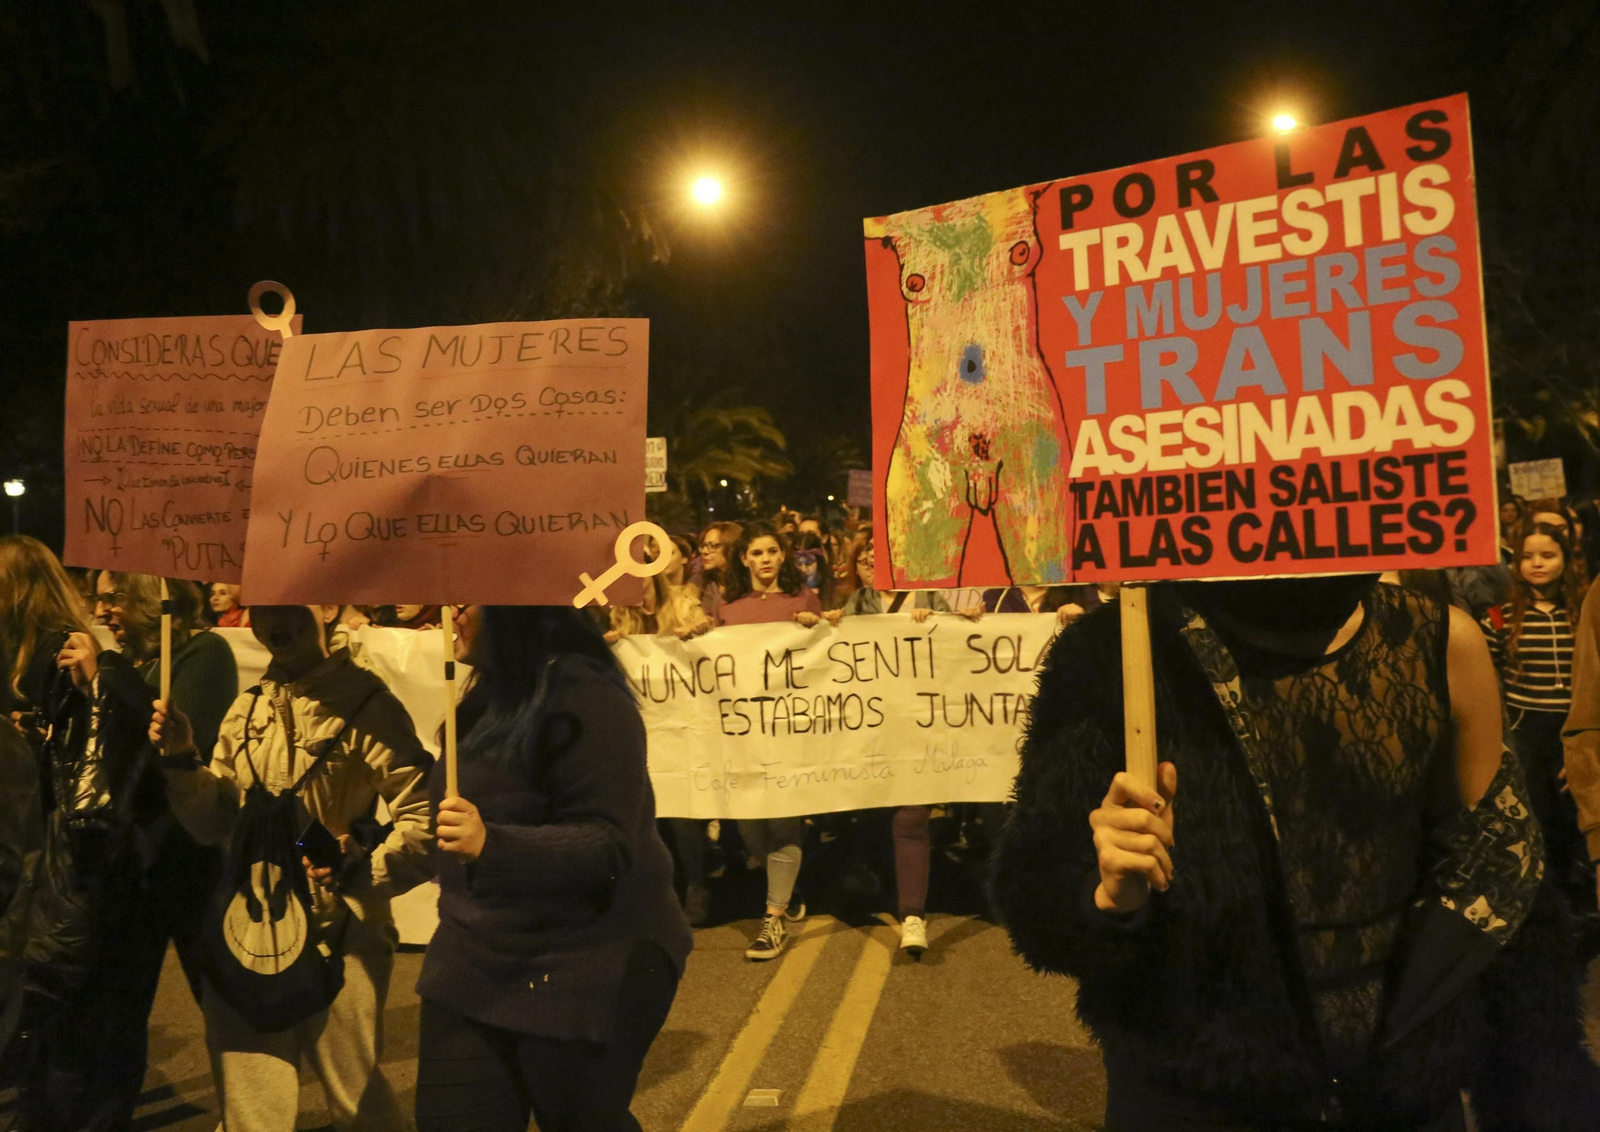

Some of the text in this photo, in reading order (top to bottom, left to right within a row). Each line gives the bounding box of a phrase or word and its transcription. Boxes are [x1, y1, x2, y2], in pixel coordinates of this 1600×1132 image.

[1059, 110, 1452, 230] POR LAS
[1059, 164, 1455, 292] TRAVESTIS
[1062, 235, 1460, 345] Y MUJERES
[76, 328, 283, 368] CONSIDERAS QUE
[305, 326, 629, 381] LAS MUJERES
[1065, 300, 1464, 415] TRANS
[298, 406, 400, 433] Deben
[414, 398, 462, 418] ser
[1068, 379, 1475, 478] ASESINADAS
[129, 435, 181, 456] DEFINE
[186, 442, 222, 462] COMO
[305, 445, 617, 485] QUIENES ELLAS QUIERAN
[1069, 466, 1255, 519] TAMBIEN
[1269, 452, 1468, 505] SALISTE
[85, 496, 124, 557] NO
[277, 510, 293, 547] Y
[346, 511, 407, 541] QUE
[417, 513, 486, 534] ELLAS
[495, 510, 630, 536] QUIERAN
[1071, 499, 1477, 570] A LAS CALLES?
[626, 653, 736, 703] NUNCA
[763, 647, 809, 691] ME
[828, 624, 938, 683] SENTÍ
[718, 692, 885, 737] ESTÁBAMOS
